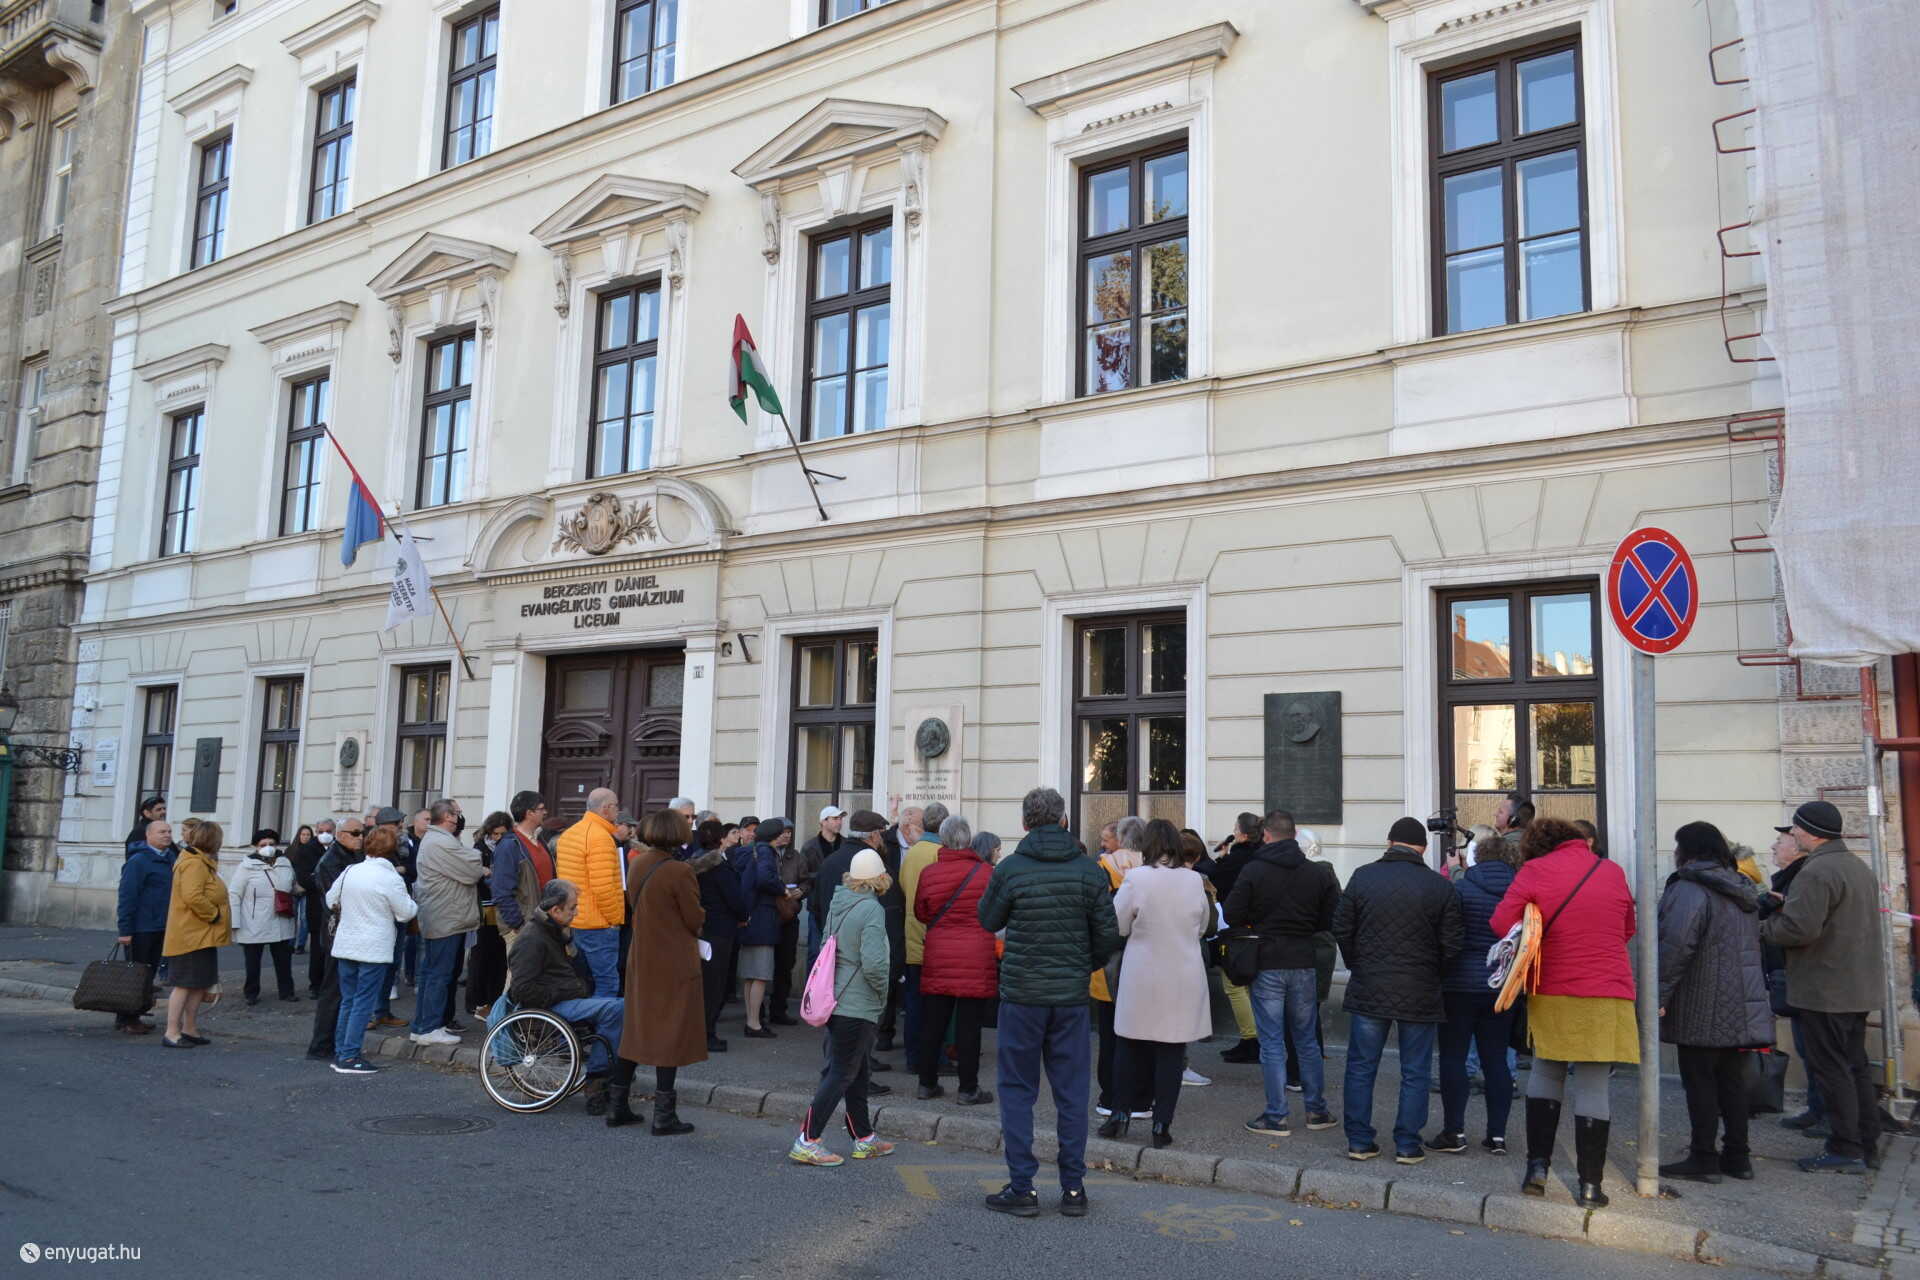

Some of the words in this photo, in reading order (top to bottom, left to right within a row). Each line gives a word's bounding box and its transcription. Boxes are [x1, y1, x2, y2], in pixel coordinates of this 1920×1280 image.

[543, 580, 607, 599] BERZSENYI
[614, 575, 659, 592] DÁNIEL
[520, 598, 602, 617] EVANGÉLIKUS
[609, 590, 684, 609] GIMNÁZIUM
[573, 611, 620, 629] LICEUM
